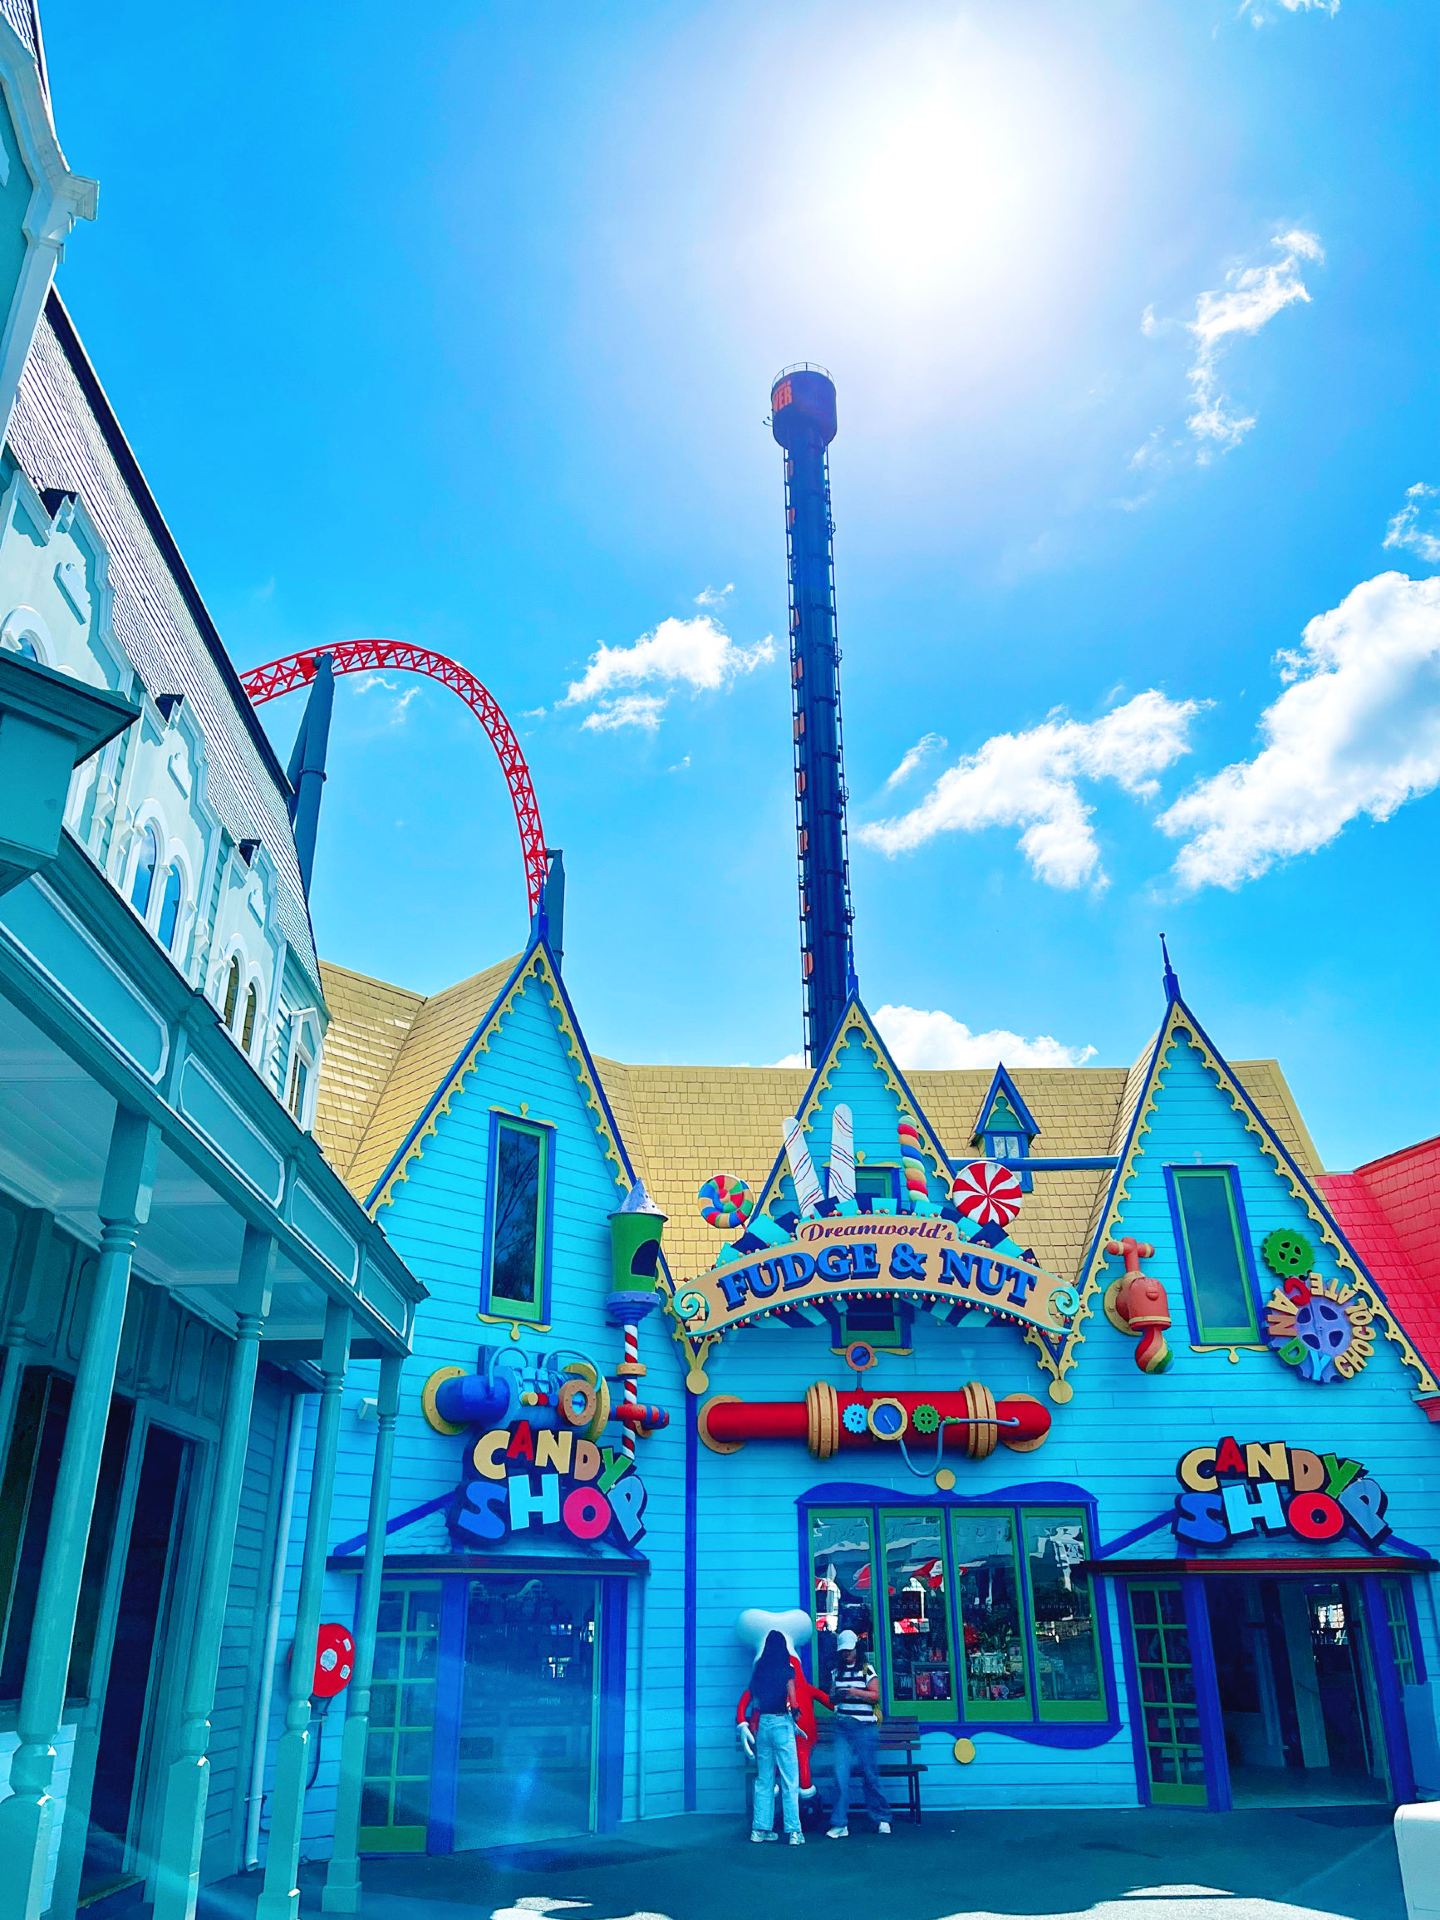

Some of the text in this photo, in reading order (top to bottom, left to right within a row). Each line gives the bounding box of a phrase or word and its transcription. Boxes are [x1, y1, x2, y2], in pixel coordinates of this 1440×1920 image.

[800, 1221, 955, 1242] Dreamworld's
[716, 1242, 1039, 1312] FUDGE & NUT
[1266, 1276, 1332, 1381] CANDY
[1309, 1271, 1377, 1379] CHOCOLATE
[473, 1420, 634, 1494] CANDY
[1180, 1436, 1362, 1499] CANDY
[457, 1473, 645, 1543] SHOP
[1176, 1477, 1387, 1543] SHOP
